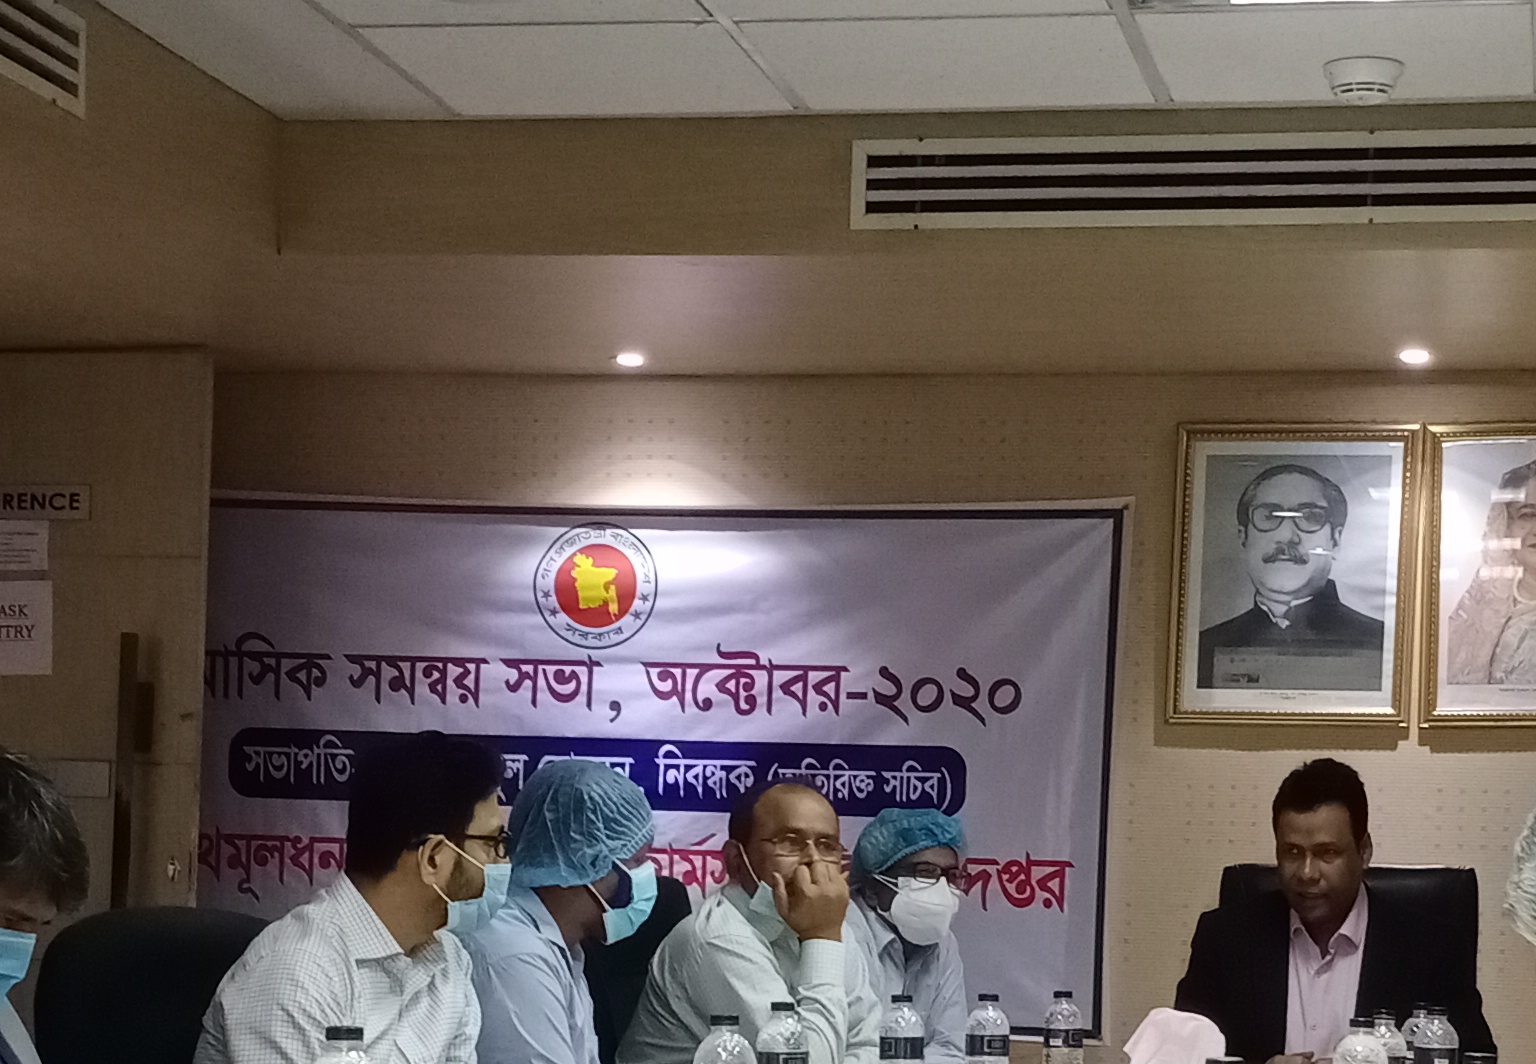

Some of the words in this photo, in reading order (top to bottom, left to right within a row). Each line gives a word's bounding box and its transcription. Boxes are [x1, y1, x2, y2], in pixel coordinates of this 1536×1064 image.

[564, 622, 624, 642] সরকার
[343, 653, 490, 708] সমন্বয়
[641, 643, 1022, 727] অক্টোবর-২০২০
[655, 744, 757, 800] নিবন্ধক
[883, 760, 953, 811] সচিব)
